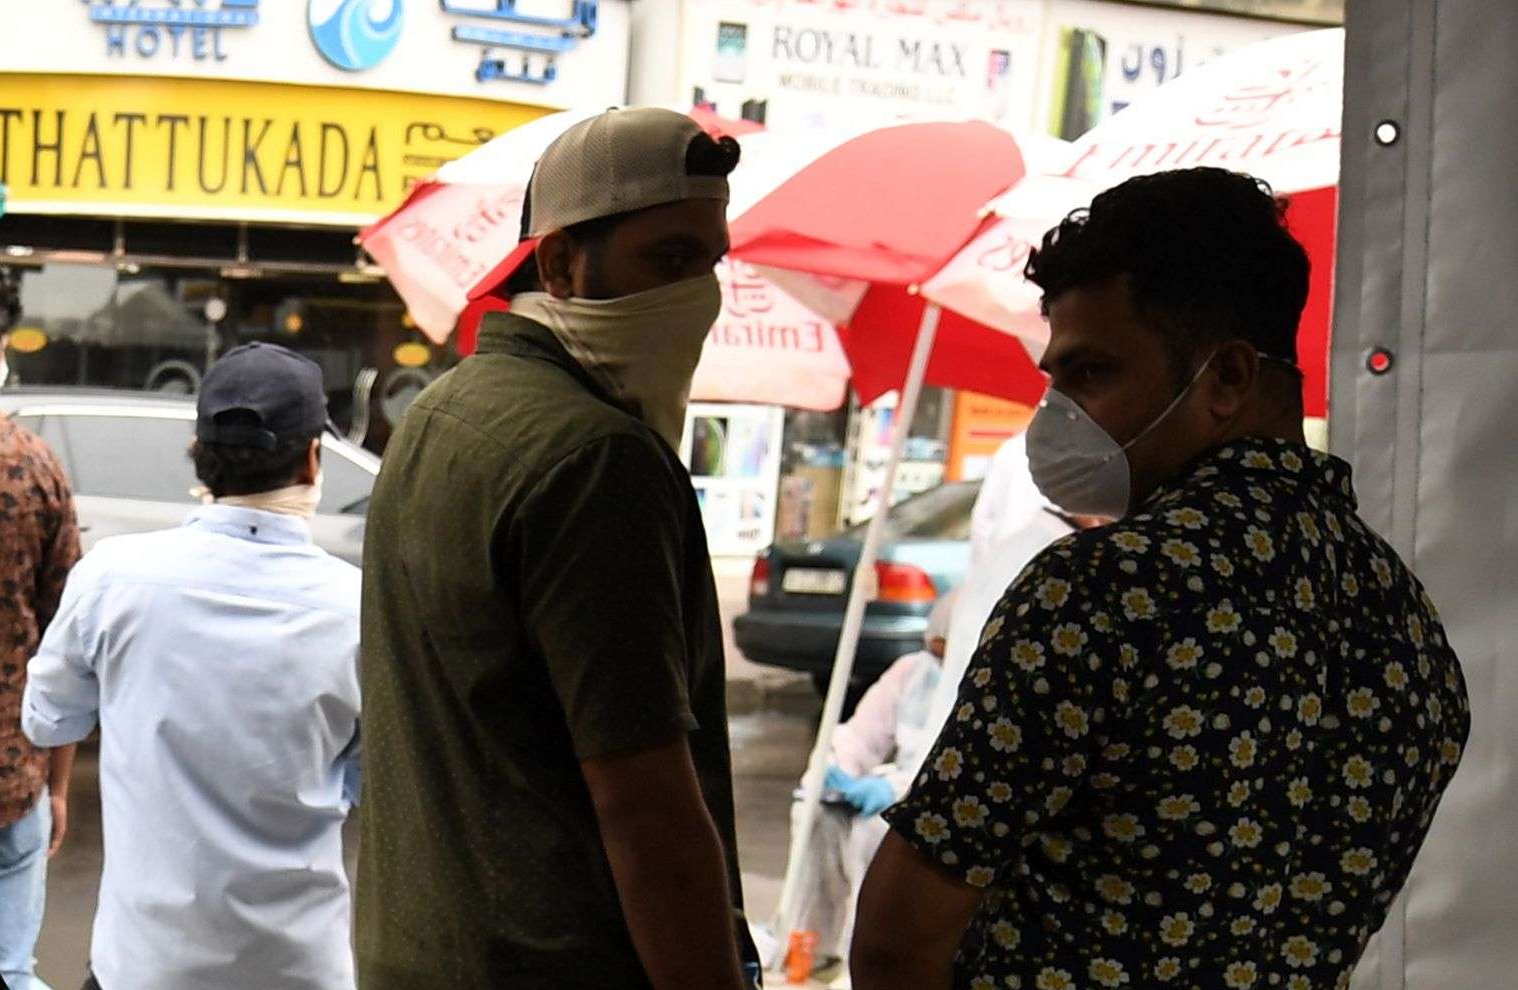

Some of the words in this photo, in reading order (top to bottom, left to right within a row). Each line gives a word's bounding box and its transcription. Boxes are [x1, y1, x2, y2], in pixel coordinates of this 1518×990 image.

[106, 24, 229, 61] HOTEL
[772, 25, 881, 69] ROYAL
[896, 37, 968, 78] MAX
